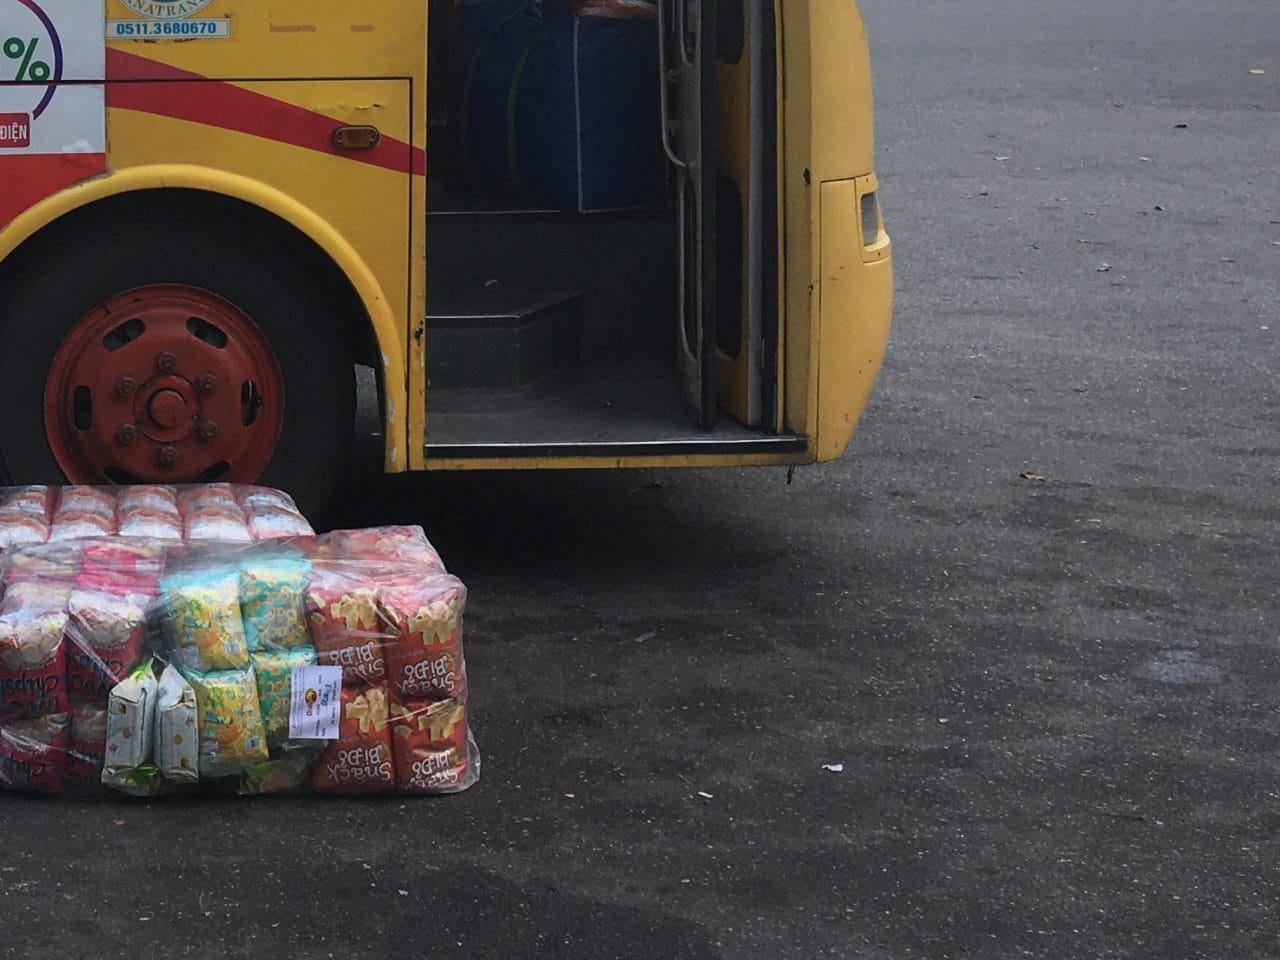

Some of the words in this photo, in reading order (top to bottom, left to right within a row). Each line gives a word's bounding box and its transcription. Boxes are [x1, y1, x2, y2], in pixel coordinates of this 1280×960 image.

[116, 22, 217, 35] 0511.3680670
[0, 122, 28, 143] ĐIỆN
[395, 672, 456, 694] Snack
[326, 761, 392, 783] Snack
